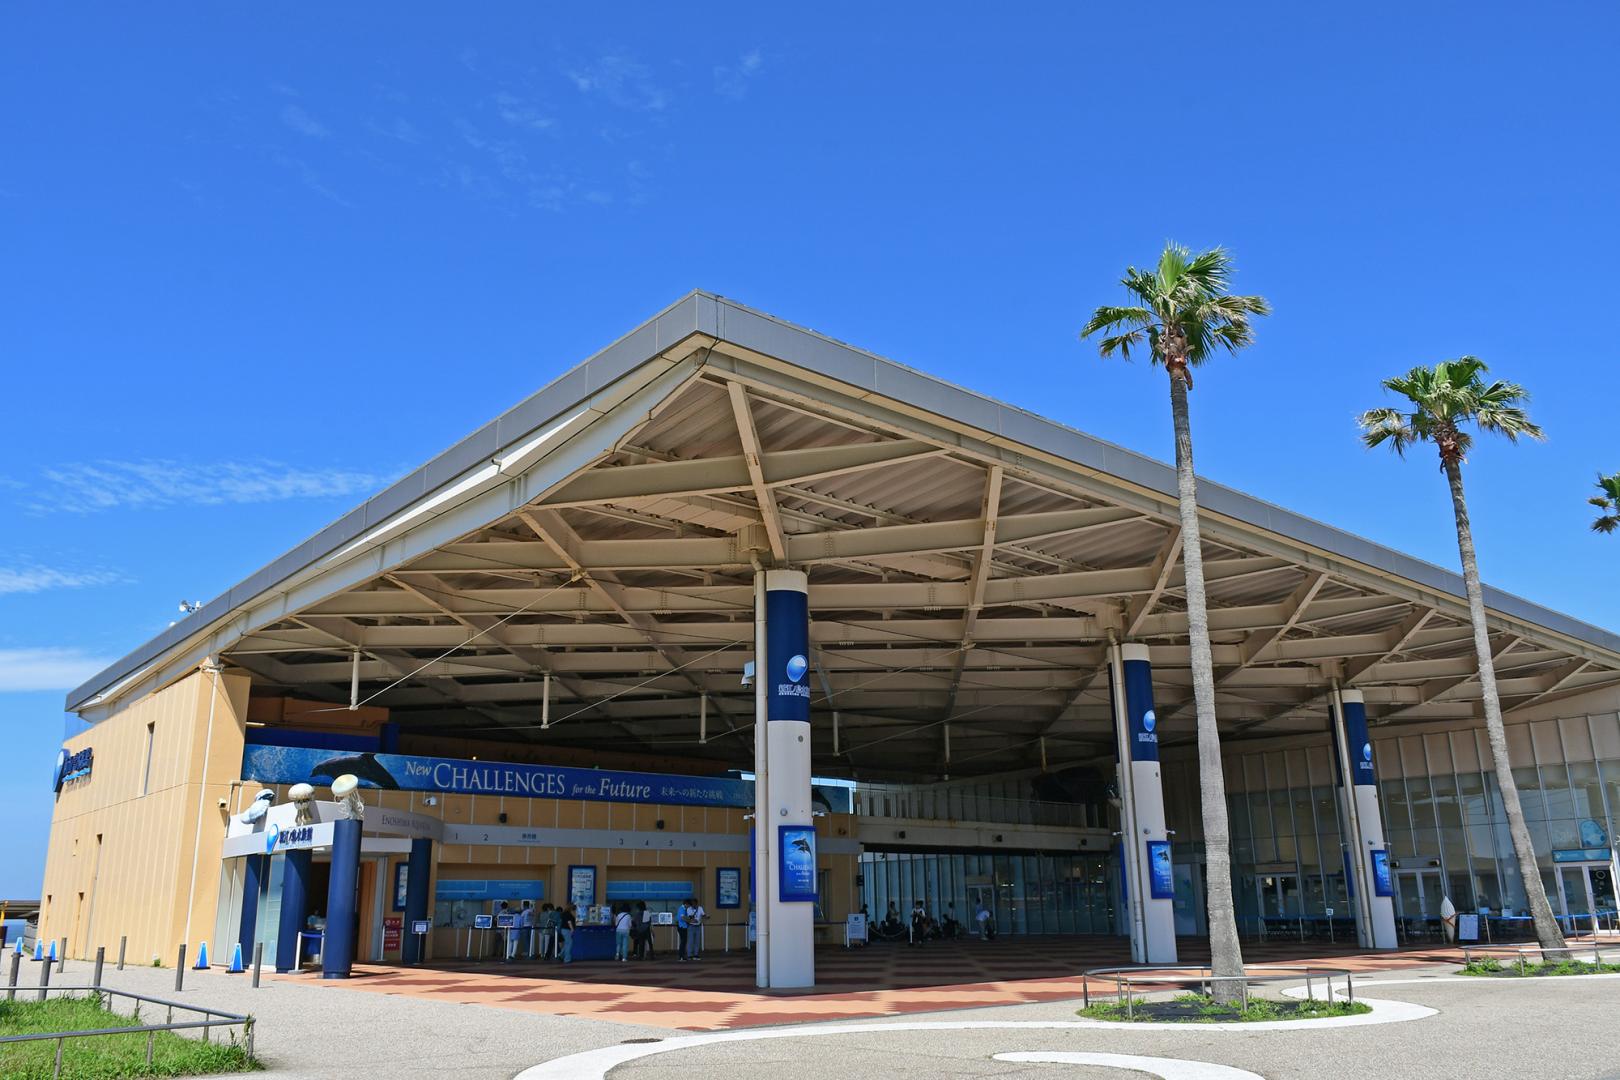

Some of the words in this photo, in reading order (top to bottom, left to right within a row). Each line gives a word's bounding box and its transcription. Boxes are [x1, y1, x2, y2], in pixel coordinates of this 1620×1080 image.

[405, 761, 432, 776] New
[433, 763, 565, 794] CHALLENGES
[571, 783, 584, 796] for
[584, 784, 597, 795] the
[599, 778, 651, 798] Future
[483, 833, 489, 841] 2
